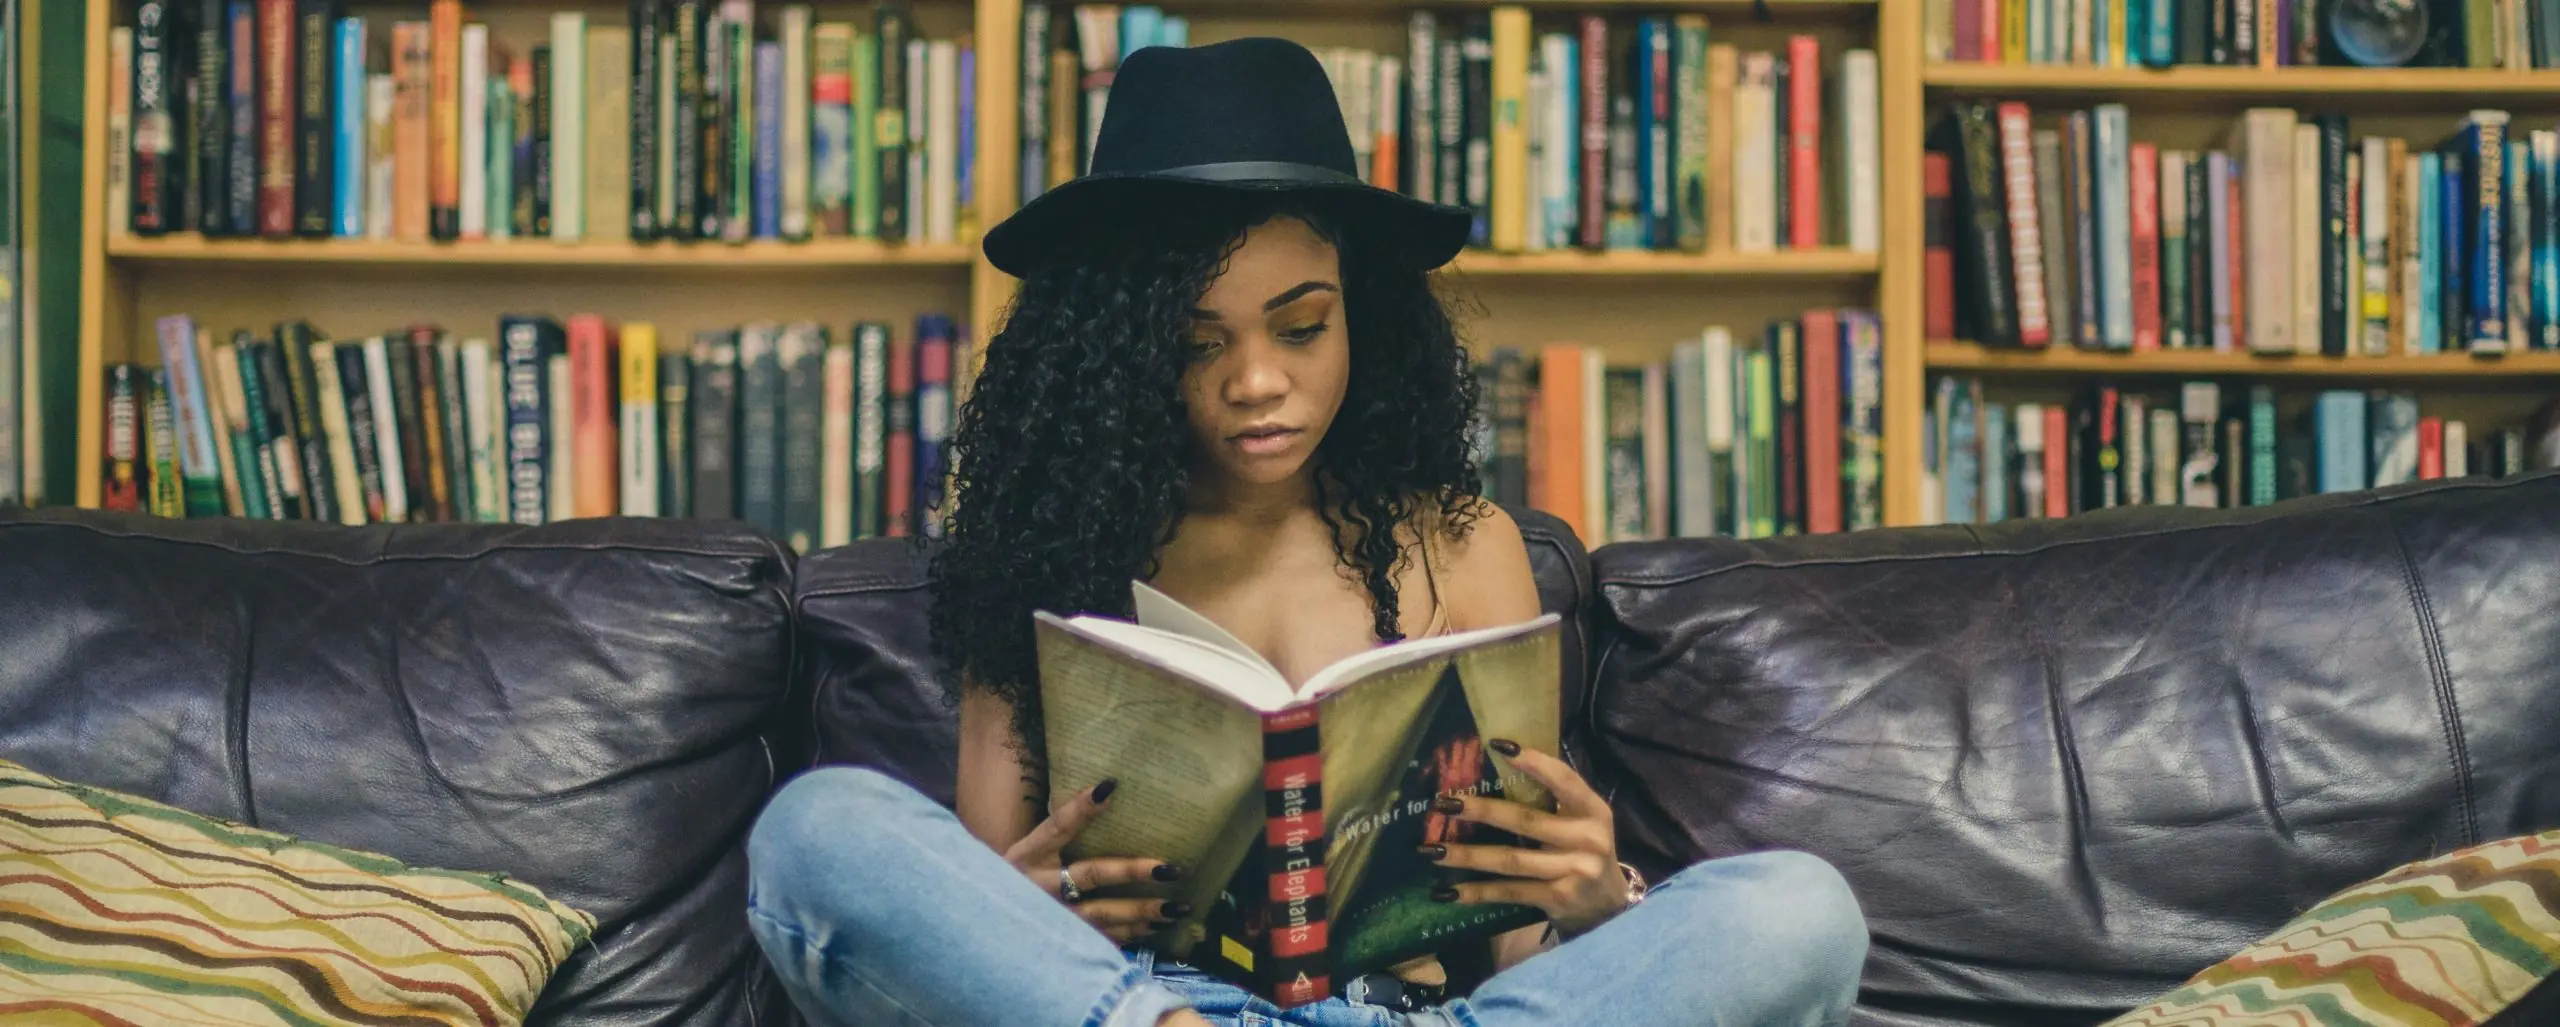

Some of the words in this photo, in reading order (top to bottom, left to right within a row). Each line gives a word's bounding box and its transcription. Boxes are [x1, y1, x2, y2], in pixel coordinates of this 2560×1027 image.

[507, 324, 538, 409] BLUE
[1284, 772, 1308, 824] Water
[1346, 807, 1400, 841] Water
[1407, 799, 1430, 816] for
[1286, 827, 1309, 853] for
[1284, 857, 1310, 943] Elephants
[1421, 920, 1466, 940] SARA
